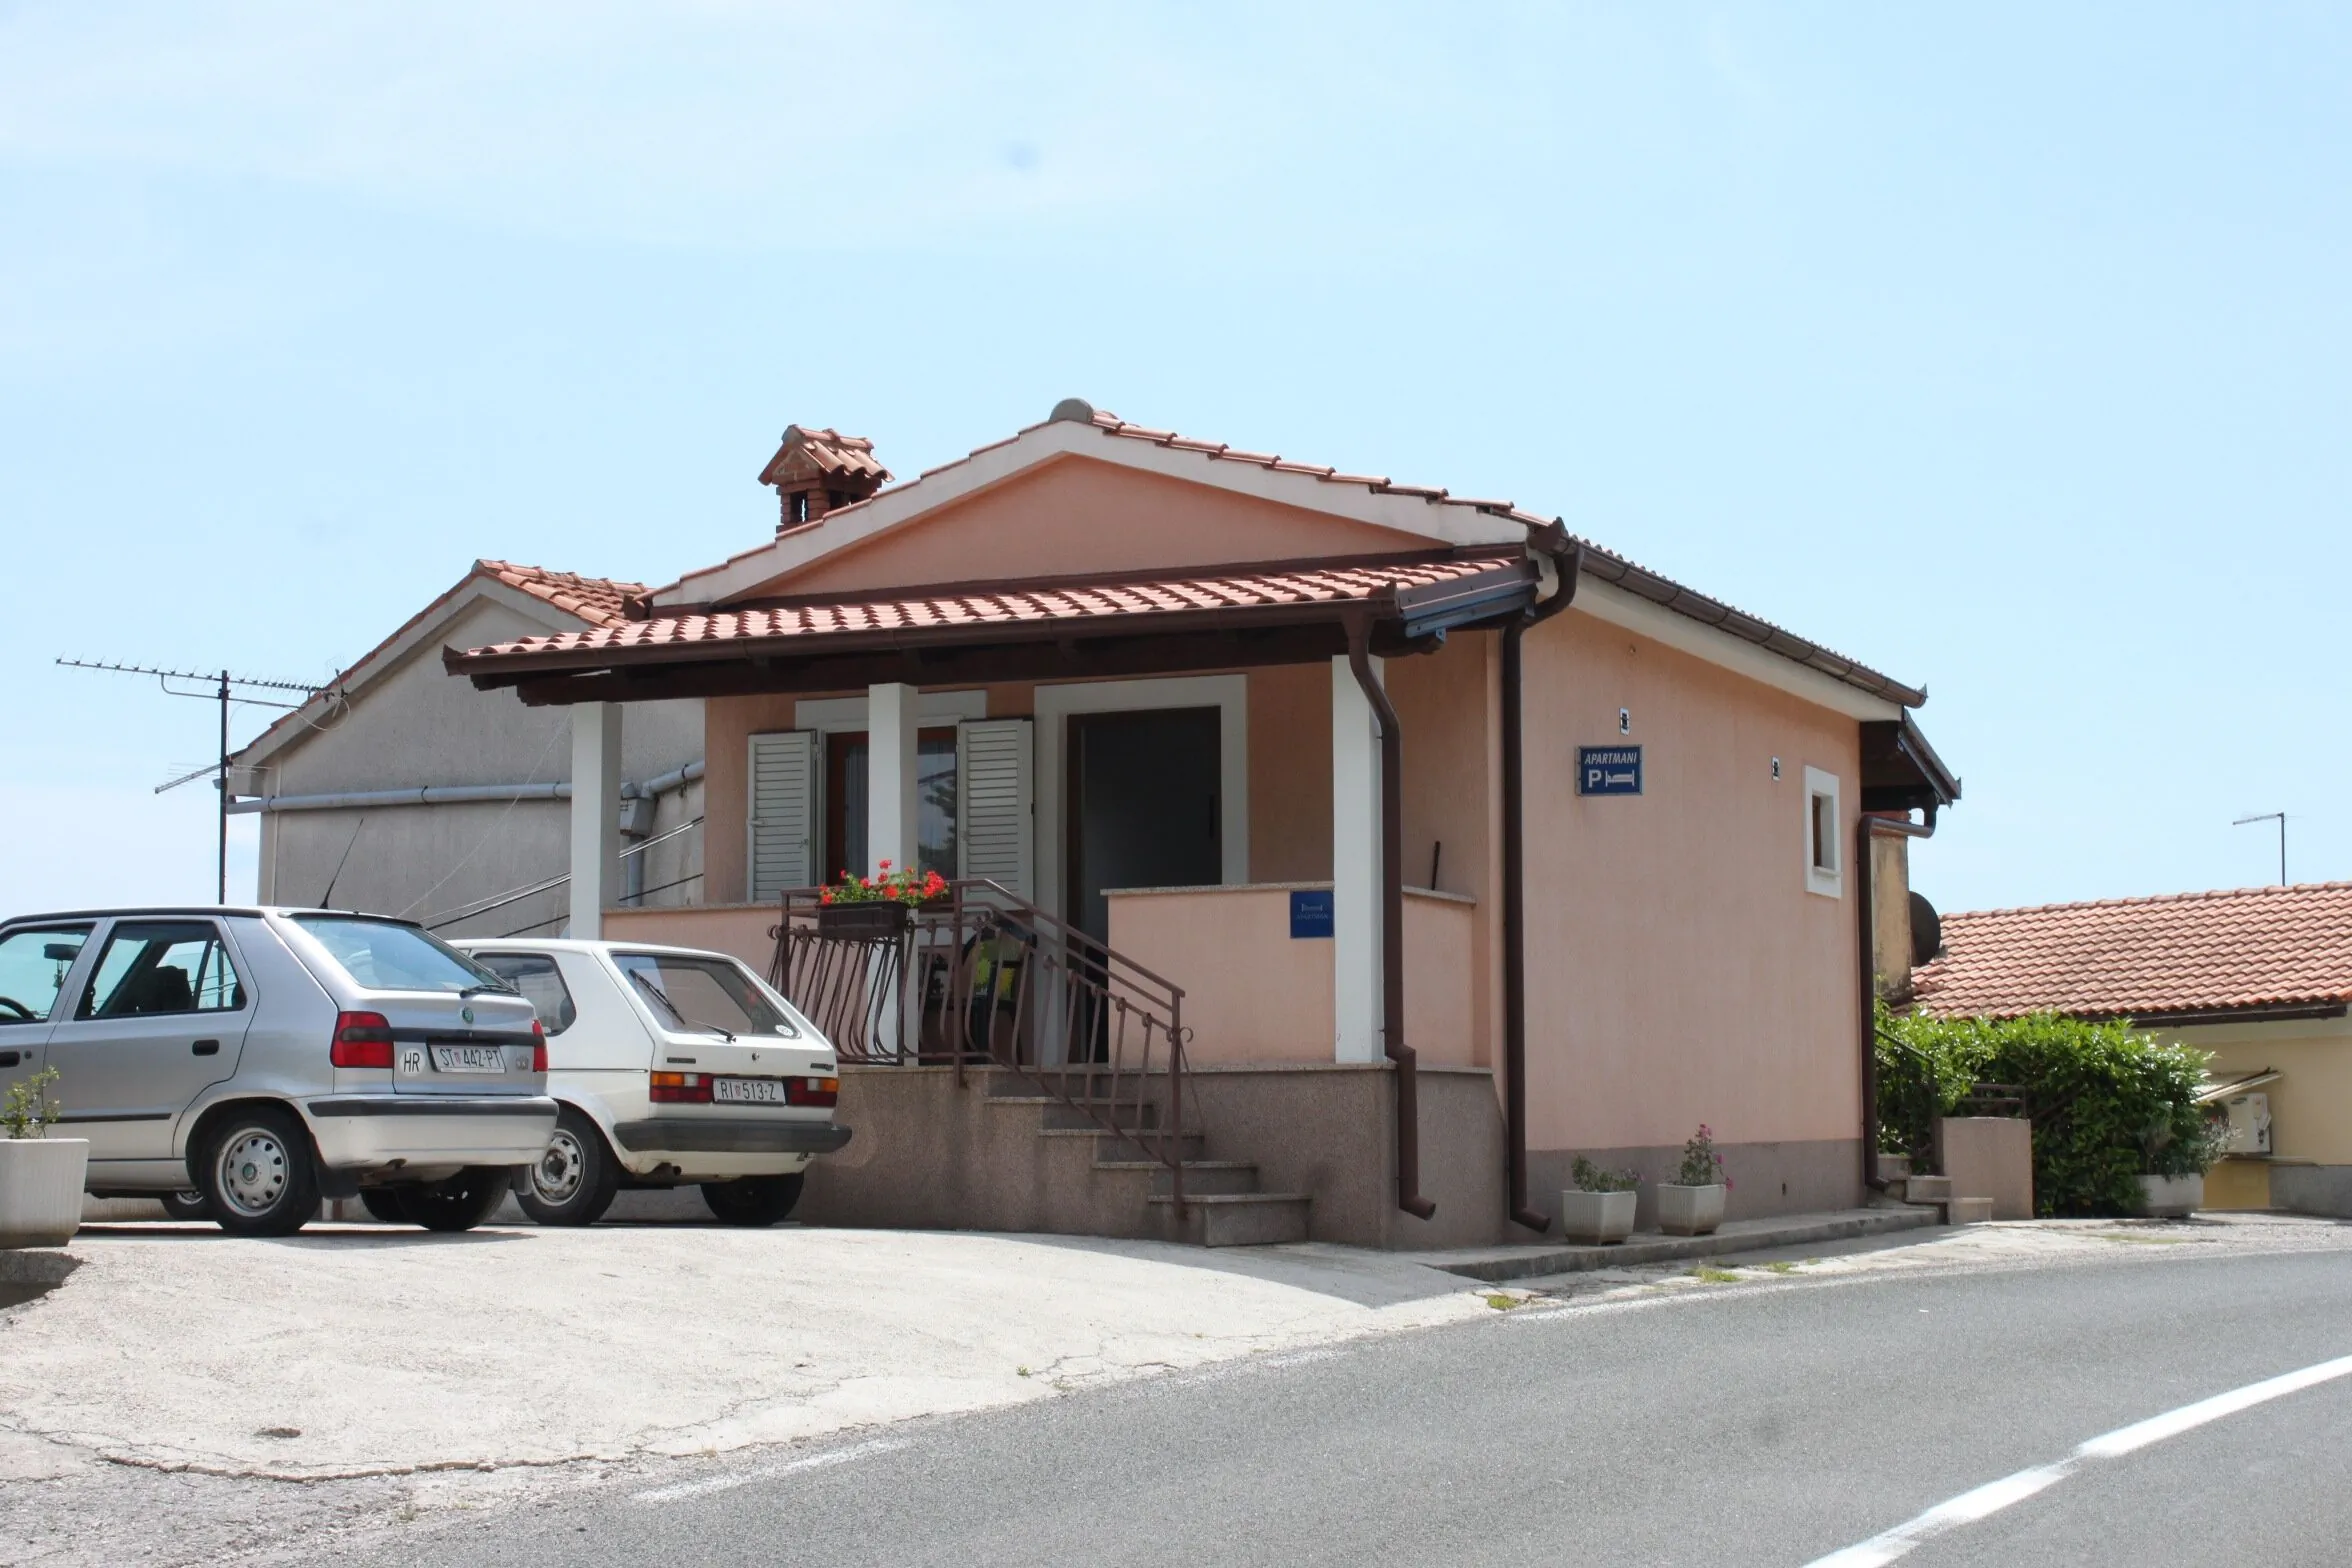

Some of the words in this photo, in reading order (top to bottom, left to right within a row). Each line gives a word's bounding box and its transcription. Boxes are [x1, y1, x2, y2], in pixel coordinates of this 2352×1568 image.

[1584, 752, 1637, 765] APARTMANI
[1588, 769, 1602, 788] P
[403, 1052, 421, 1073] HR
